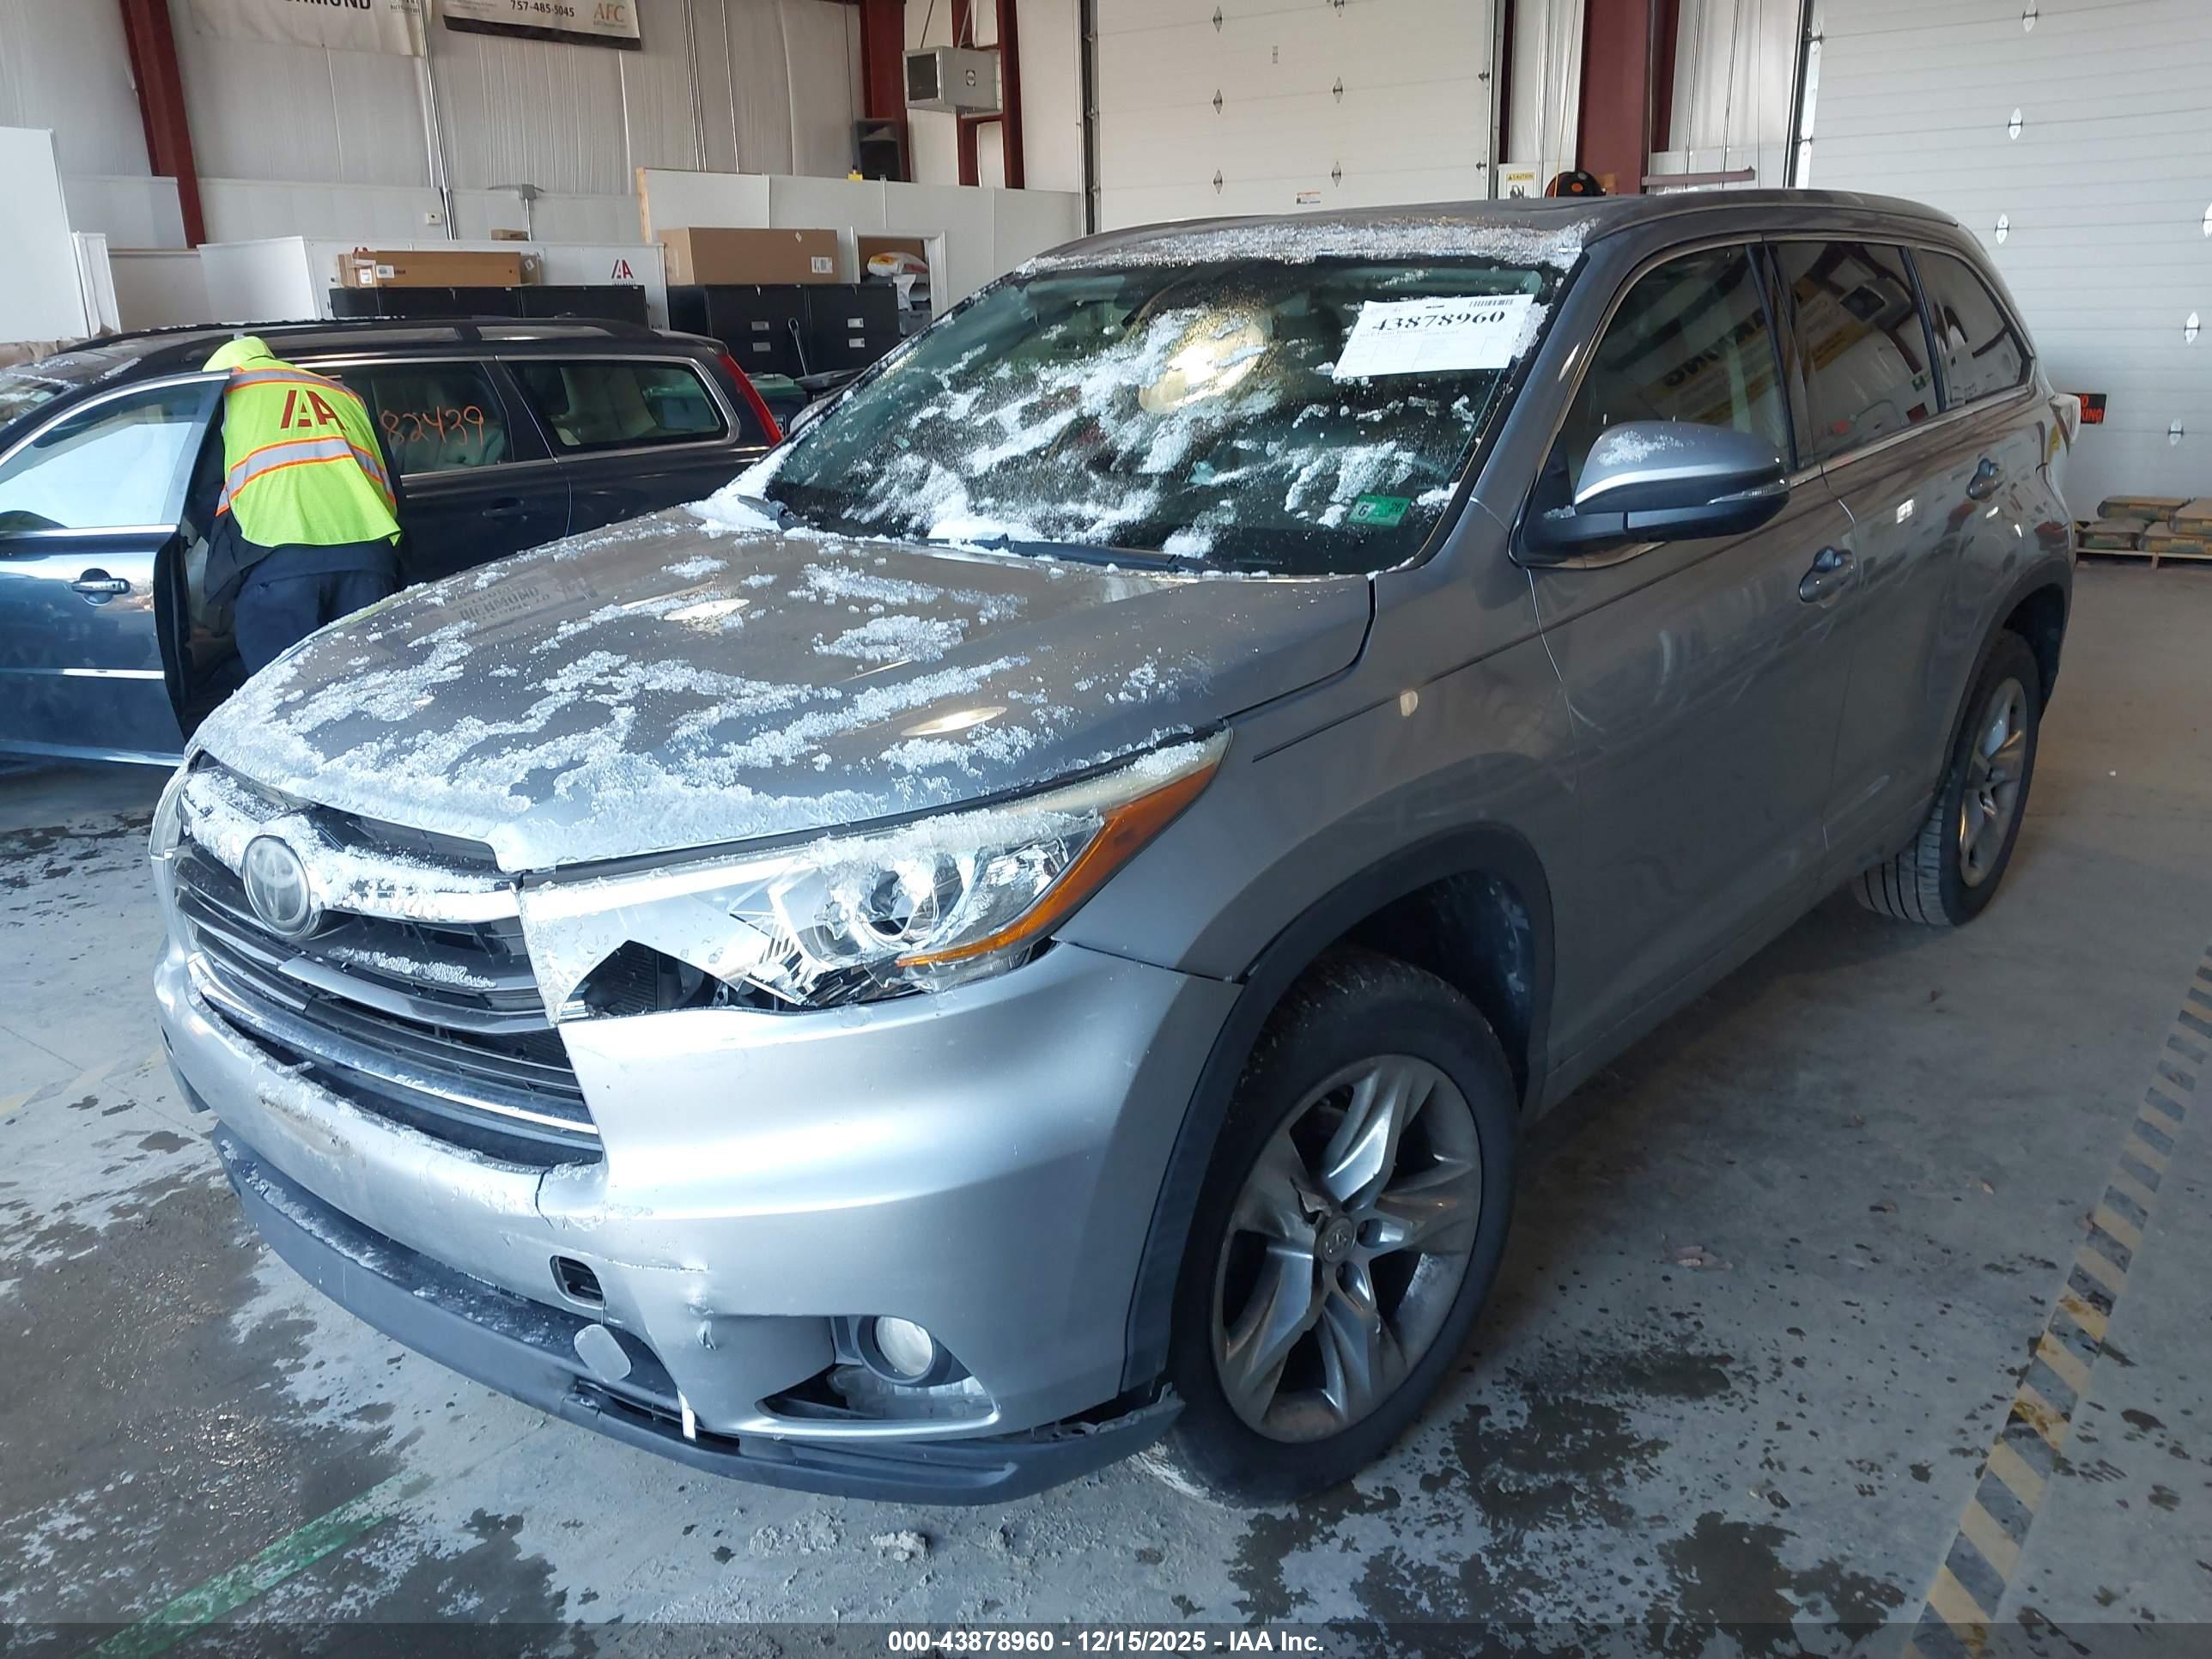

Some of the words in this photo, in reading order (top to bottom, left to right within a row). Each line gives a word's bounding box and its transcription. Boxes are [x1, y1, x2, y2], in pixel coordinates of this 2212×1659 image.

[593, 3, 626, 22] AFC
[1372, 310, 1505, 331] 43878960
[380, 405, 483, 447] 82439
